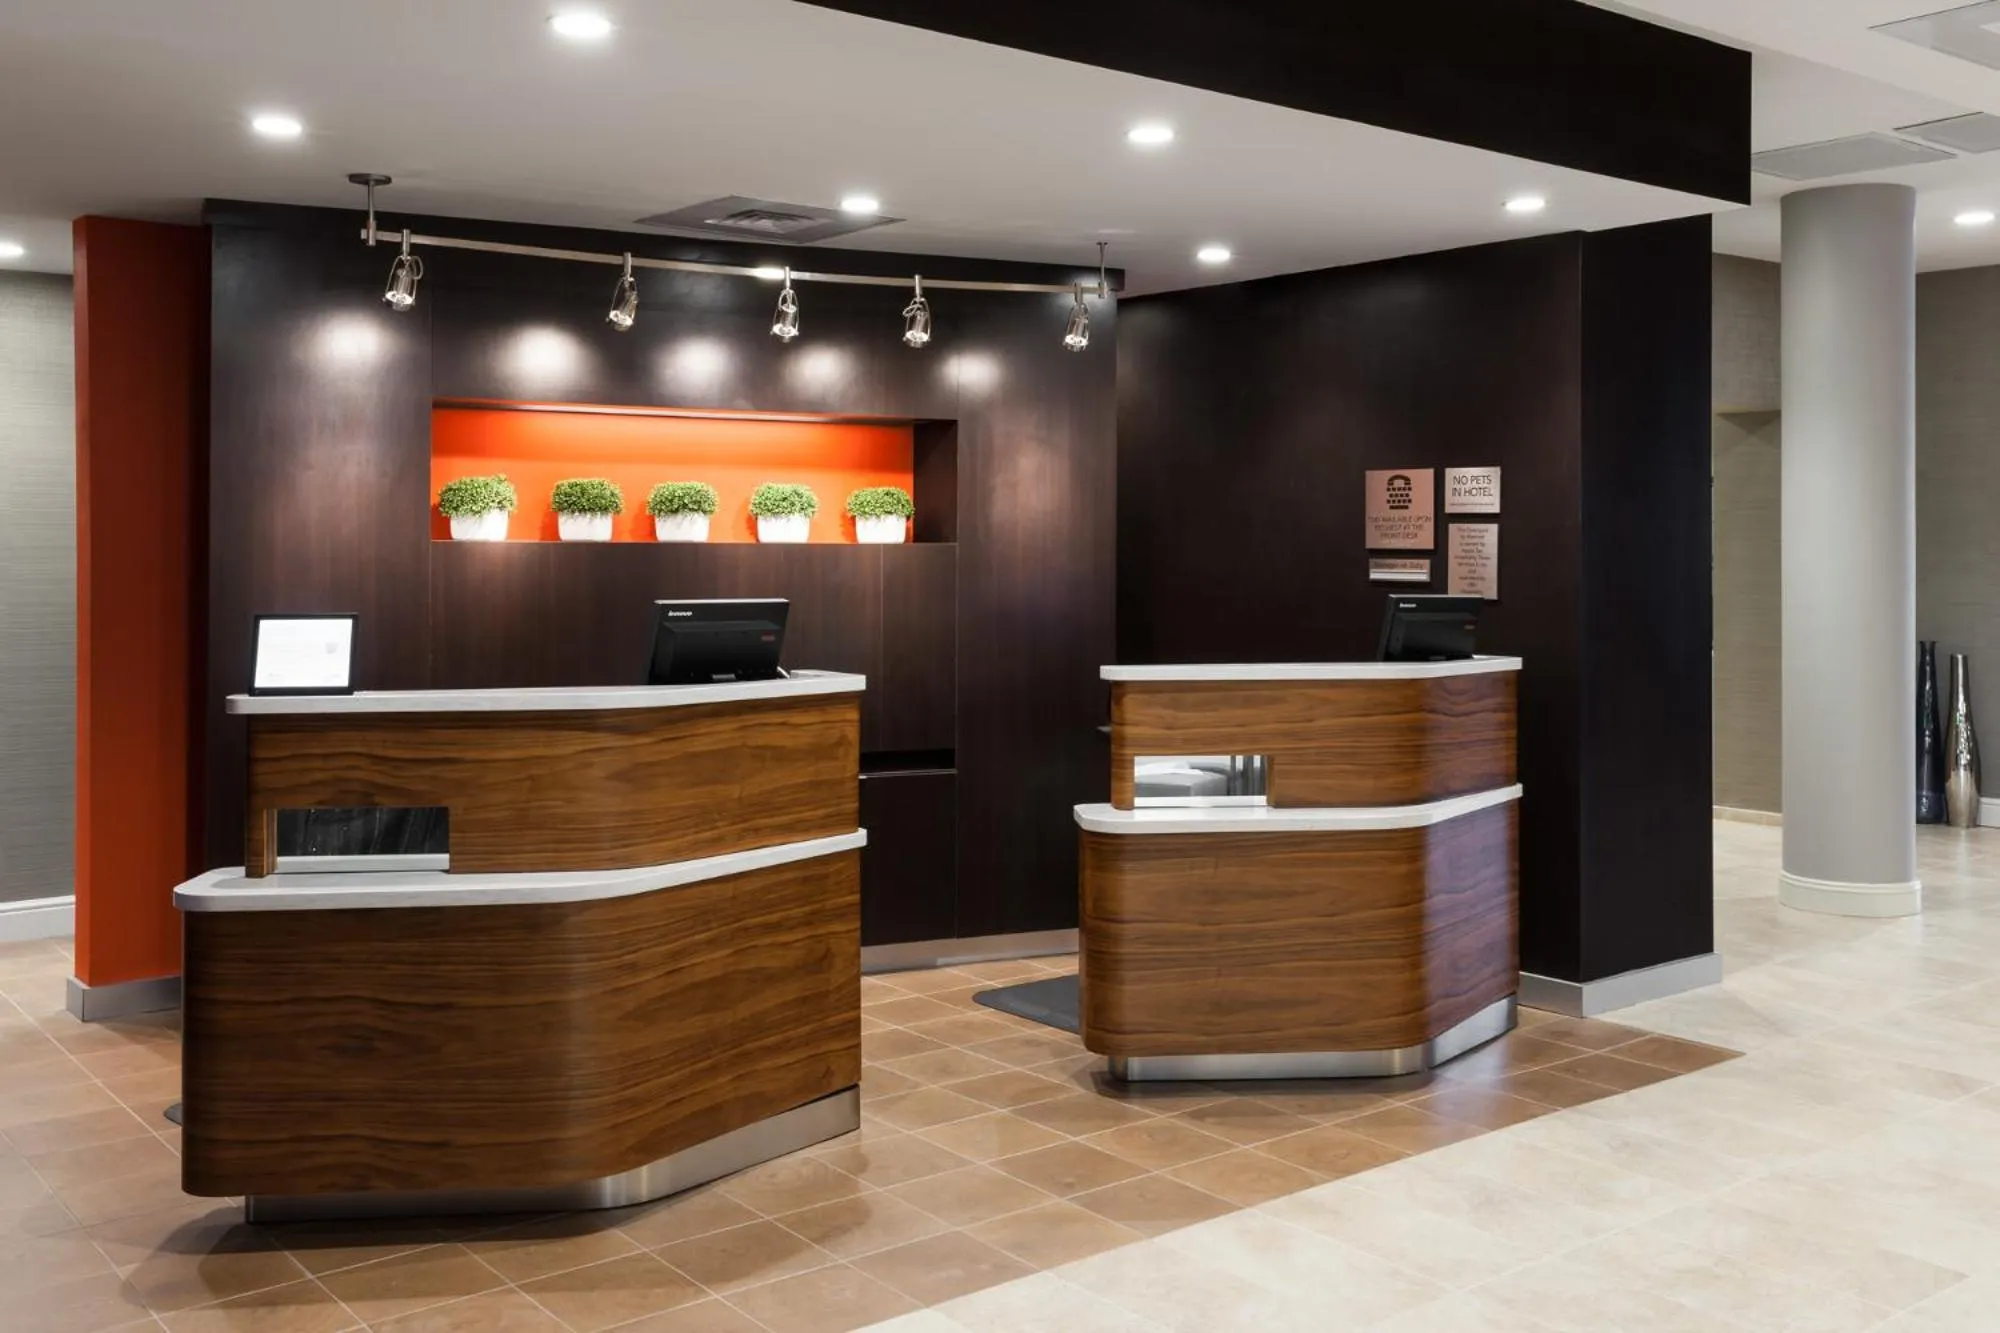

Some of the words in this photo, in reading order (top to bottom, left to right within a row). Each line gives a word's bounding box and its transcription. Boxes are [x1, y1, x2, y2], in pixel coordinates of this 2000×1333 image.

[1453, 475, 1468, 485] NO
[1471, 475, 1492, 485] PETS
[1452, 487, 1461, 497] IN
[1464, 487, 1493, 497] HOTEL
